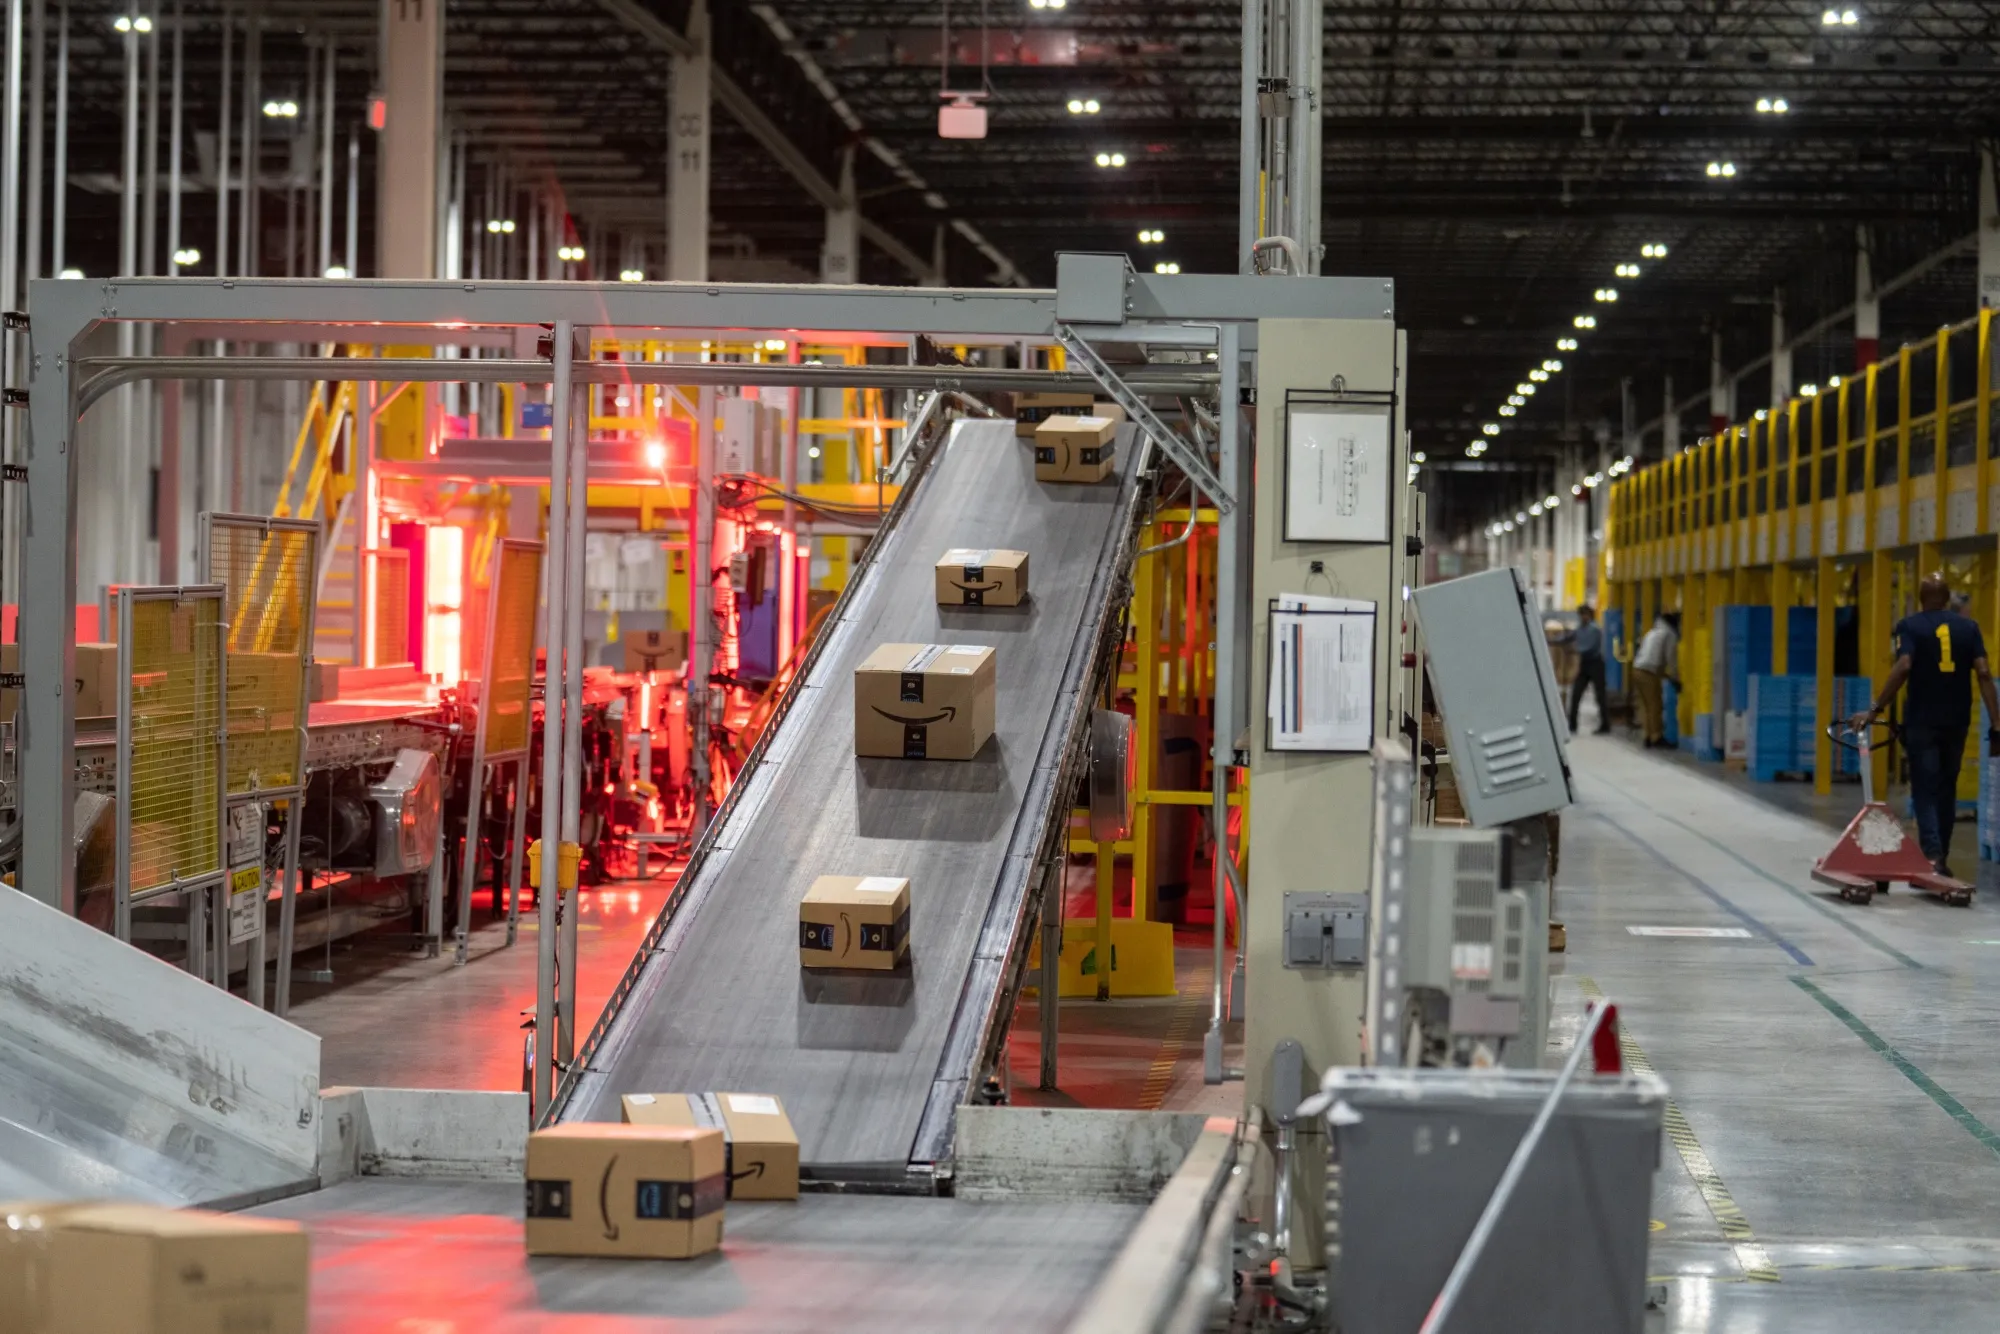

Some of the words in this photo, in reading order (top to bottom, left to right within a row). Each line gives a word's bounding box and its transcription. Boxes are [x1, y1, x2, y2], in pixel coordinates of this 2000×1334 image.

[681, 149, 700, 173] 11
[1935, 623, 1956, 673] 1
[237, 871, 260, 891] CAUTION
